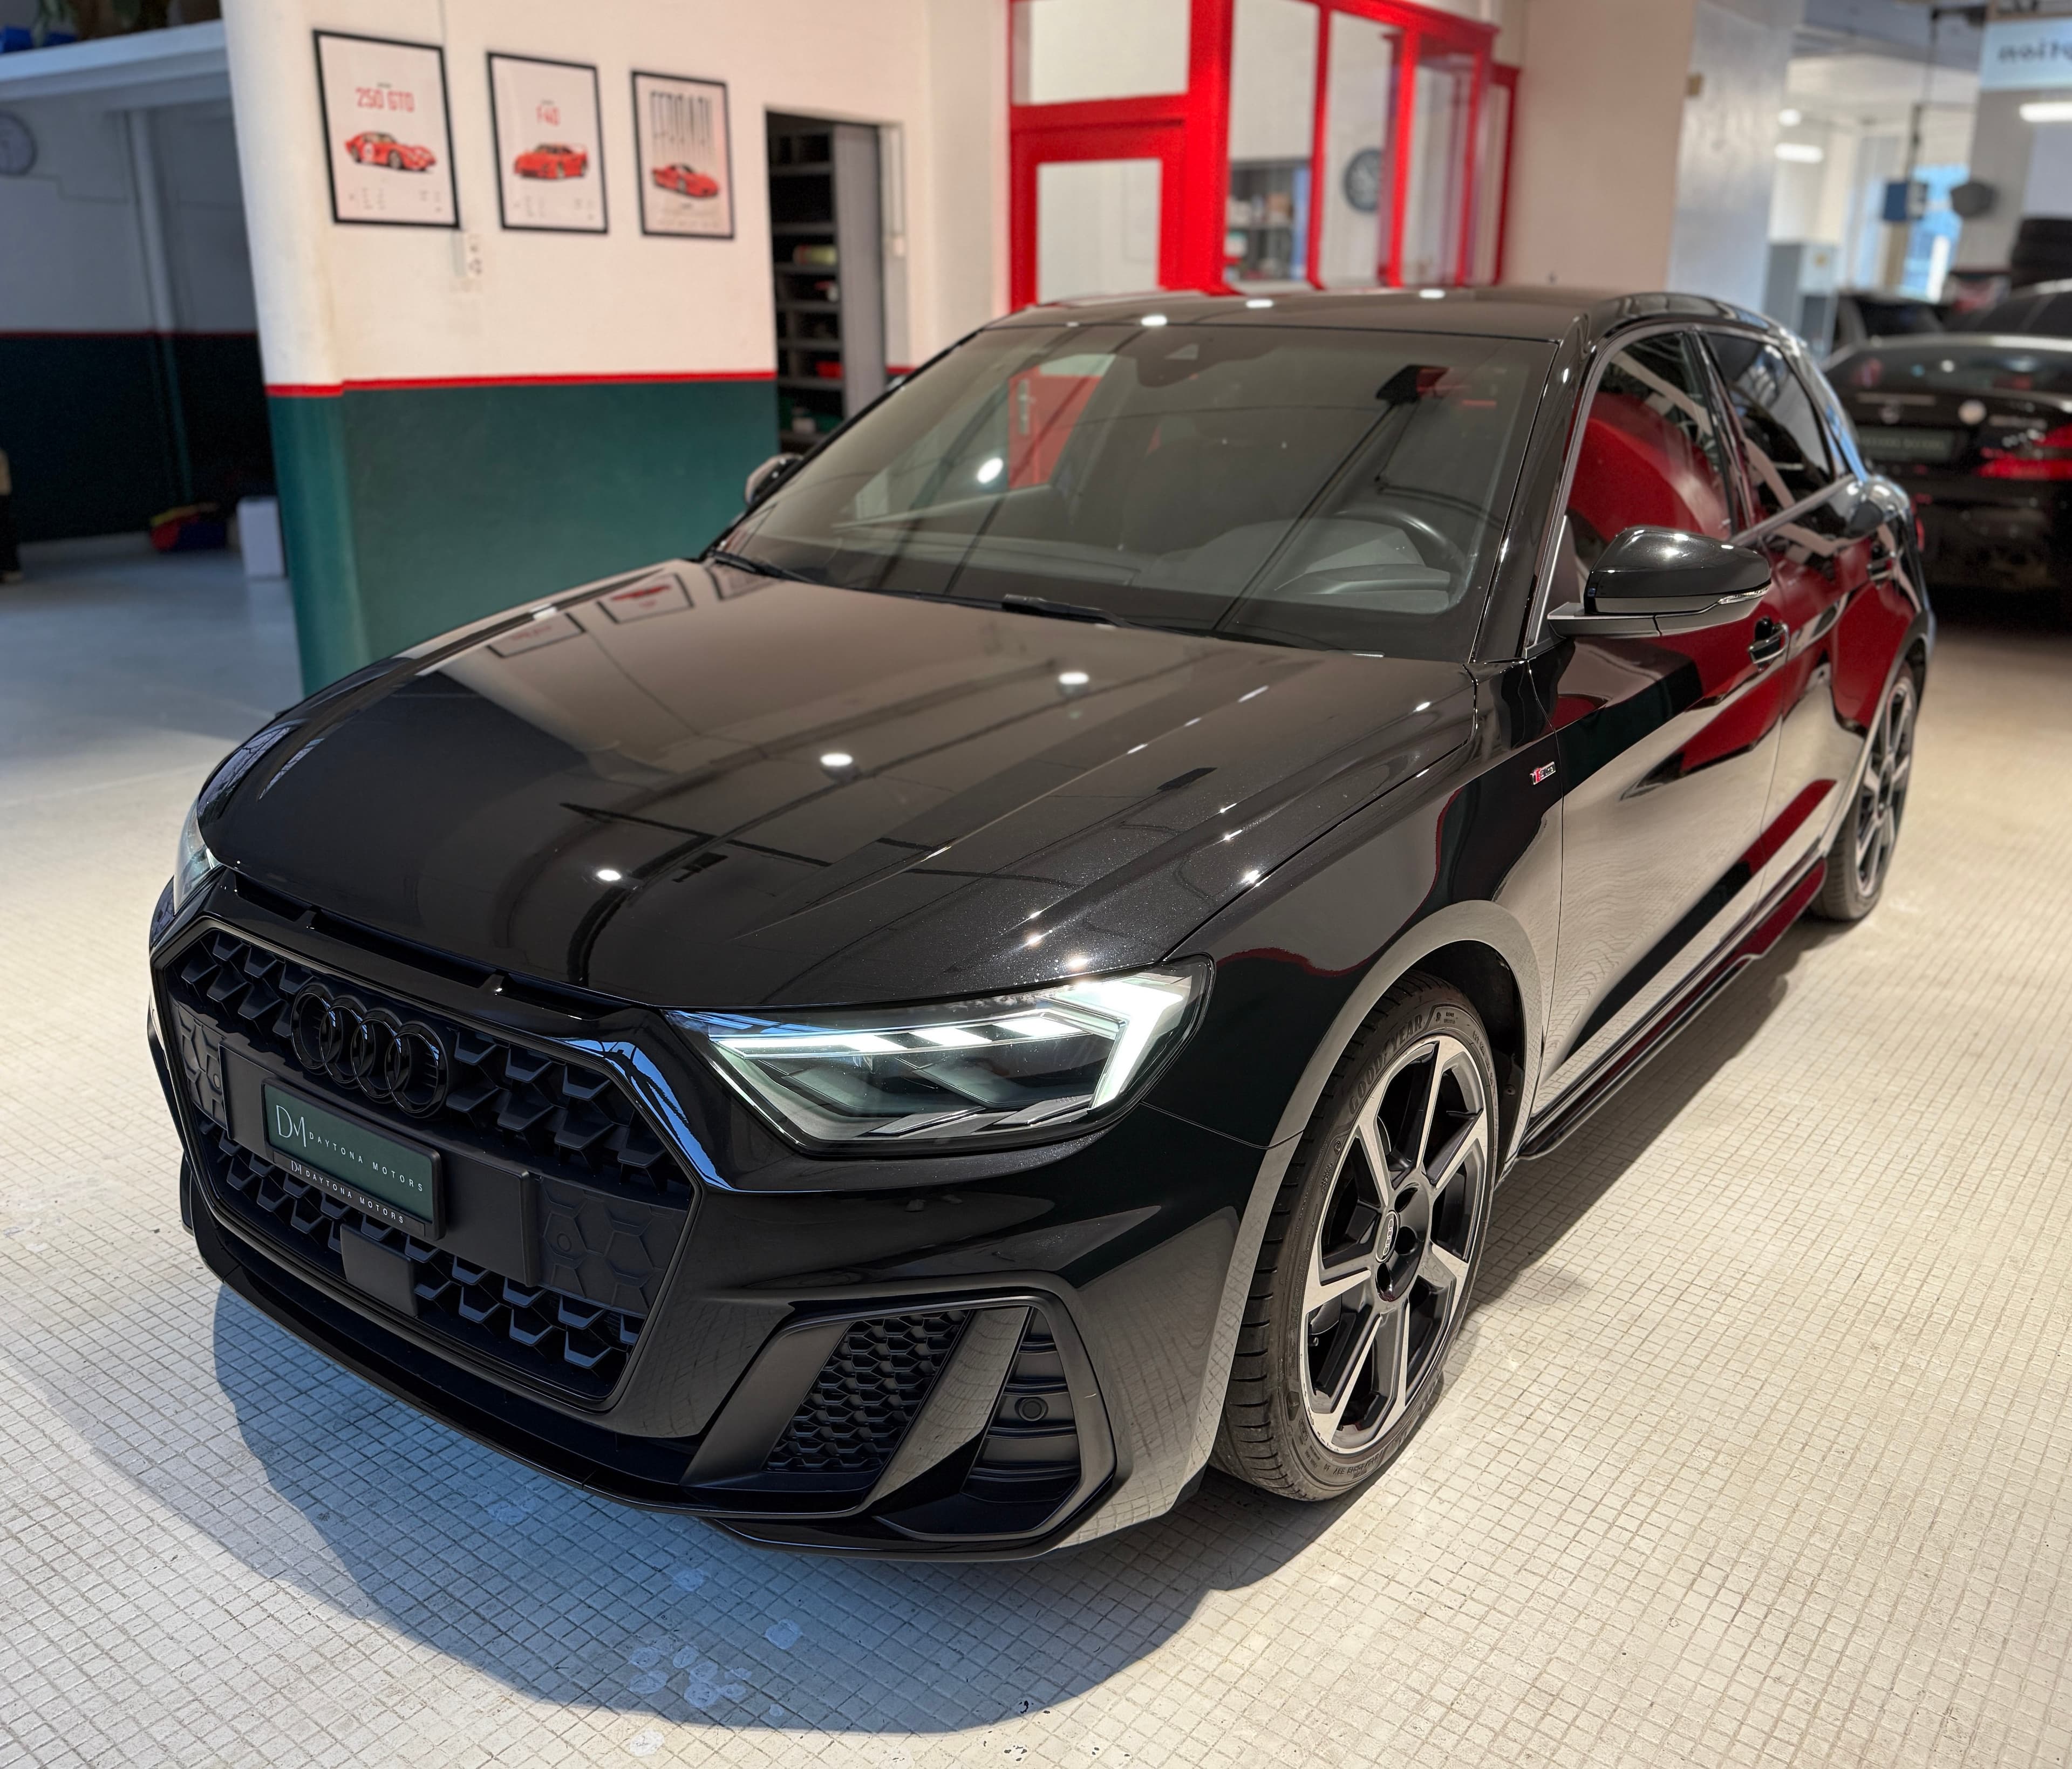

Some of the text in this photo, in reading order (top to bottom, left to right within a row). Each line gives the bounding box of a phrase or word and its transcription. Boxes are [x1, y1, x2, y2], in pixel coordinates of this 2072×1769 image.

[355, 87, 415, 113] 250 GTO
[309, 1131, 363, 1164] DAYTONA
[372, 1161, 423, 1192] MOTORS
[305, 1170, 352, 1199] DAYTONA
[359, 1197, 404, 1224] MOTORS
